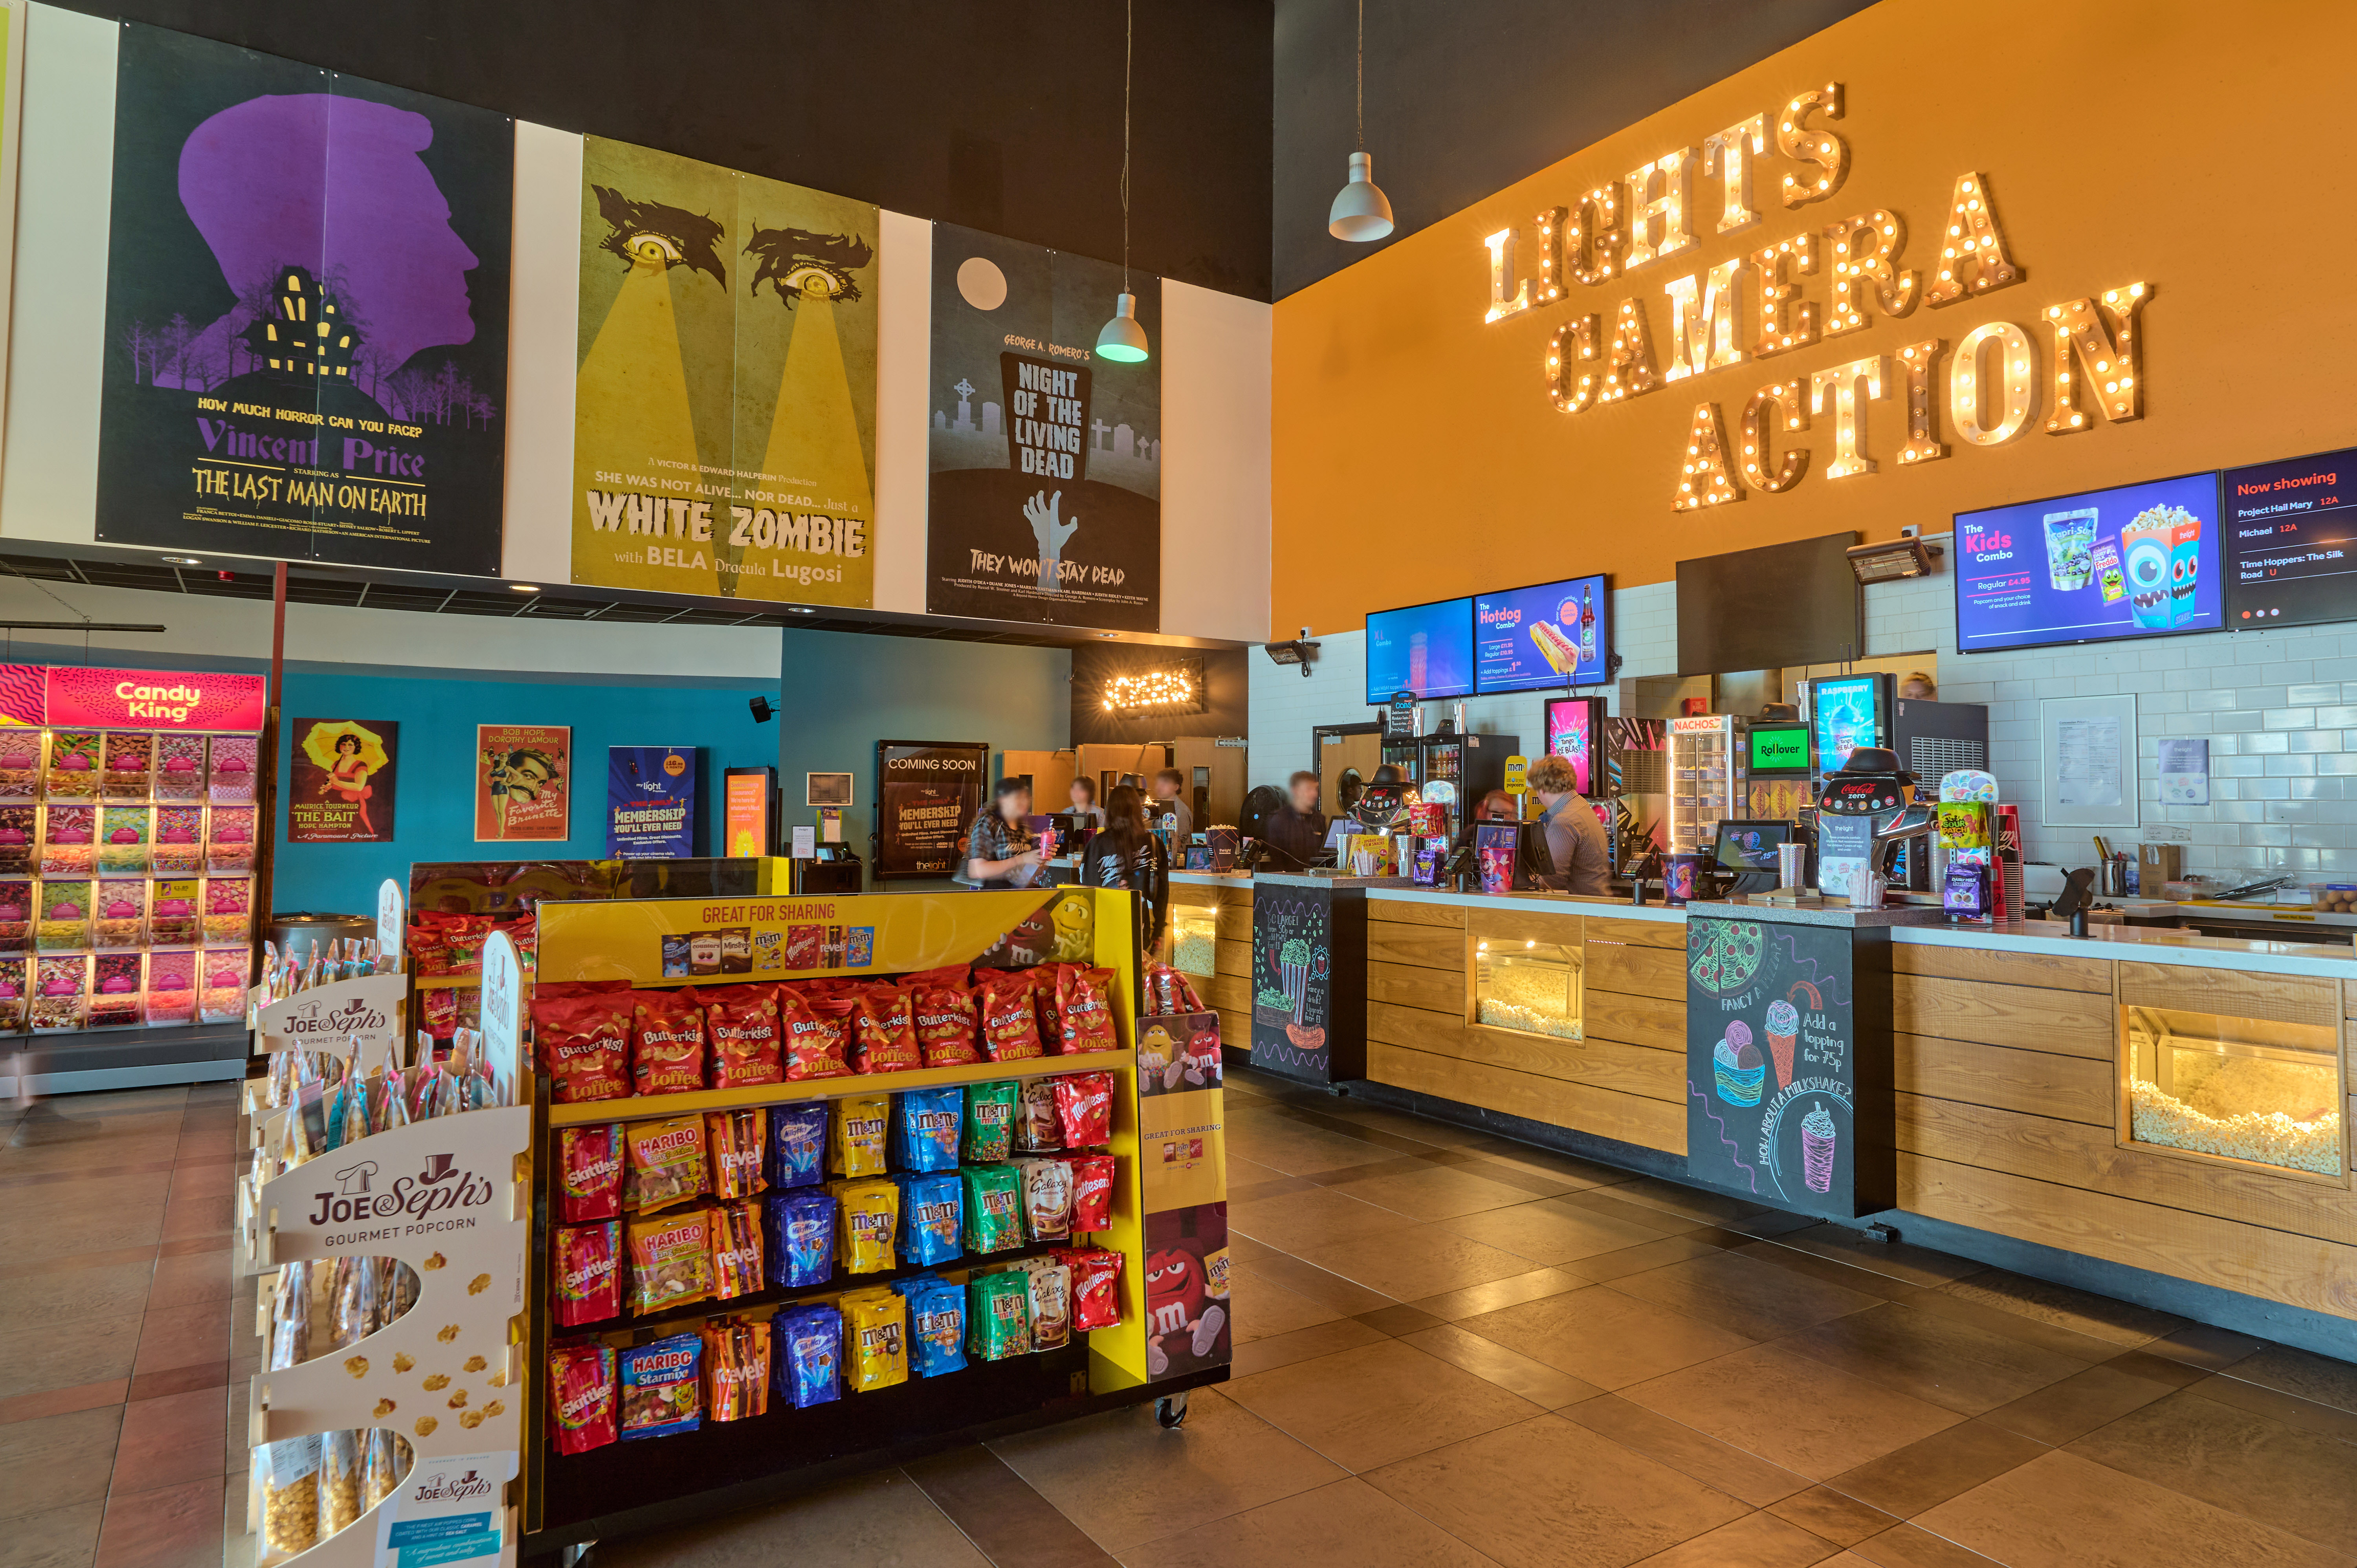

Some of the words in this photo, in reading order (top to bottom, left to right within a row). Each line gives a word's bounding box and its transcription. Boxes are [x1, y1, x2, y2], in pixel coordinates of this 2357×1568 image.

[1484, 81, 1845, 324] LIGHTS
[1545, 171, 2026, 413] CAMERA
[1004, 334, 1036, 350] GEORGE
[1037, 341, 1046, 352] A.
[1048, 343, 1090, 361] ROMERO'S
[1018, 362, 1077, 397] NIGHT
[1014, 390, 1037, 417] OF
[1047, 396, 1082, 426] THE
[1670, 280, 2154, 513] ACTION
[198, 397, 228, 412] HOW
[232, 403, 271, 418] MUCH
[275, 408, 324, 425] HORROR
[329, 416, 353, 429] CAN
[359, 419, 383, 433] YOU
[388, 423, 422, 438] FACE?
[197, 417, 319, 465] Vincent
[343, 437, 425, 477] Price
[1015, 418, 1080, 454] LIVING
[294, 468, 328, 477] STARRING
[648, 458, 655, 466] A
[657, 459, 689, 471] VICTOR
[699, 465, 734, 476] EDWARD
[737, 470, 777, 482] HALPERIN
[779, 474, 817, 487] Production
[1021, 448, 1073, 479] DEAD
[192, 467, 230, 501] THE
[234, 473, 282, 508] LAST
[286, 480, 334, 513] MAN
[338, 485, 366, 512] ON
[371, 488, 426, 519] EARTH
[595, 471, 622, 484] SHE
[626, 474, 657, 488] WAS
[661, 478, 693, 492] NOT
[695, 482, 741, 499] ALIVE...
[745, 489, 774, 502] NOR
[778, 493, 820, 508] DEAD...
[823, 498, 849, 512] Just
[852, 504, 858, 513] a
[2238, 483, 2270, 496] Now
[2274, 473, 2336, 490] showing
[2238, 506, 2269, 517] Project
[2271, 503, 2288, 512] Hail
[2290, 500, 2313, 509] Mary
[2320, 496, 2339, 505] 12A
[587, 489, 715, 542] WHITE
[729, 506, 865, 558] ZOMBIE
[1965, 524, 1983, 534] The
[2240, 527, 2272, 538] Michael
[2280, 524, 2297, 532] 12A
[1966, 530, 2012, 553] Kids
[614, 551, 643, 564] with
[647, 546, 707, 570] BELA
[714, 558, 766, 576] Dracula
[773, 559, 842, 586] Lugosi
[970, 549, 1005, 574] THEY
[1008, 555, 1058, 582] WON'T
[1056, 560, 1089, 584] STAY
[1092, 566, 1125, 587] DEAD
[1976, 550, 2013, 563] Combo
[2240, 561, 2263, 569] Time
[2264, 555, 2305, 567] Hoppers:
[2307, 553, 2325, 561] The
[2326, 550, 2344, 559] Silk
[1978, 579, 2007, 591] Regular
[2008, 577, 2030, 586] £4.95
[2241, 570, 2263, 579] Road
[1480, 607, 1521, 624] Hotdog
[115, 681, 200, 707] Candy
[1821, 685, 1868, 695] RASPBERRY
[129, 702, 187, 722] King
[1674, 719, 1714, 730] NACHOS
[1556, 747, 1565, 755] ICE
[1565, 745, 1581, 754] BLAST
[1761, 742, 1800, 757] Rollover
[889, 759, 939, 769] COMING
[942, 760, 975, 770] SOON
[614, 824, 641, 833] YOU'LL
[643, 823, 661, 832] EVER
[663, 822, 682, 830] NEED
[615, 808, 685, 824] MEMBERSHIP
[703, 905, 746, 923] GREAT
[749, 905, 773, 921] FOR
[780, 903, 834, 920] SHARING
[1721, 992, 1753, 1011] FANCY
[1754, 986, 1764, 1000] A
[1763, 943, 1782, 988] PIZZA?
[717, 1025, 772, 1039] Butterkist
[1803, 1012, 1826, 1031] Add
[1829, 1022, 1836, 1031] a
[1805, 1032, 1844, 1055] topping
[728, 1064, 774, 1080] toffee
[1804, 1049, 1820, 1062] for
[1822, 1051, 1842, 1072] 75p
[1777, 1090, 1786, 1103] A
[1784, 1077, 1851, 1098] MILKSHAKE?
[1761, 1100, 1781, 1136] ABOUT
[1760, 1136, 1770, 1165] HOW
[567, 1159, 619, 1187] Skittles
[1030, 1178, 1067, 1195] Galaxy
[325, 1227, 399, 1247] GOURMET
[406, 1216, 476, 1236] POPCORN
[1076, 1270, 1114, 1301] Maltesers
[633, 1350, 693, 1374] HARIBO
[639, 1368, 685, 1386] Starmix
